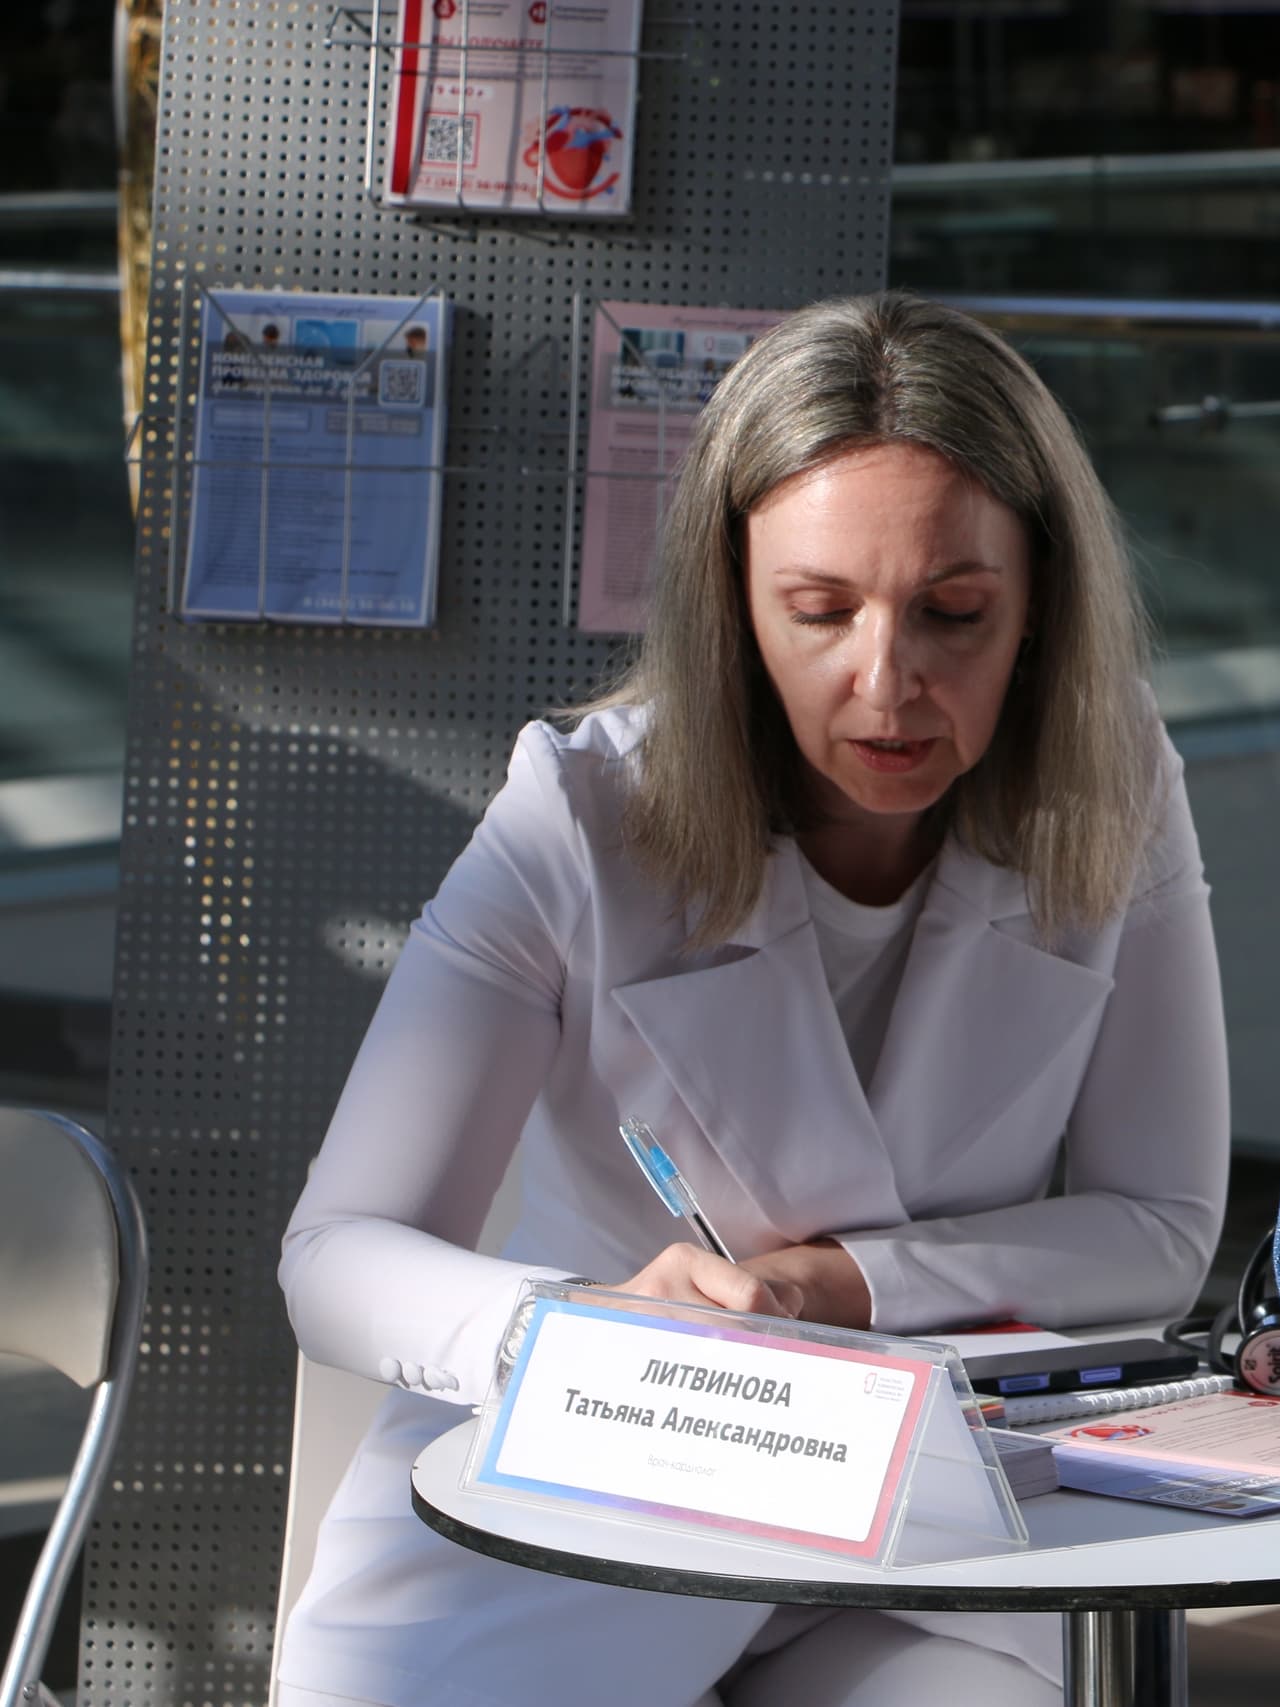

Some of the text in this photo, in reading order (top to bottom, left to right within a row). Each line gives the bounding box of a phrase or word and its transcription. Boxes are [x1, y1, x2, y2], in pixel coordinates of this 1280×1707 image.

[640, 1358, 792, 1407] ЛИТВИНОВА
[563, 1388, 848, 1463] Татьяна Александровна
